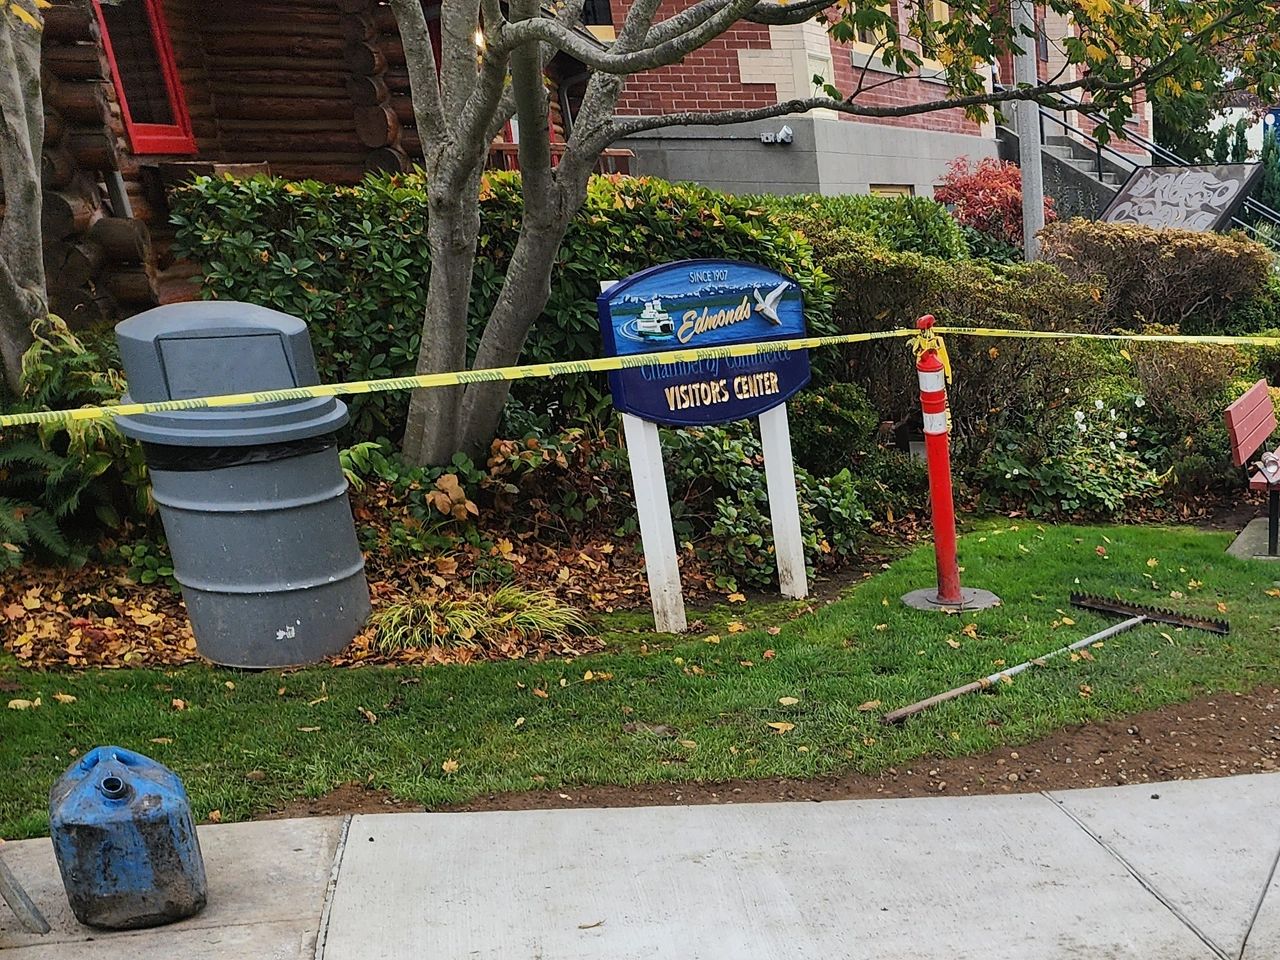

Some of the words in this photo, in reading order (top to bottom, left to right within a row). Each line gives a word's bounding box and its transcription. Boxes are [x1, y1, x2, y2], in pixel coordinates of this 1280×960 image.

[689, 271, 713, 283] SINCE
[712, 269, 729, 282] 1907
[676, 295, 751, 344] Edmonds
[664, 379, 729, 411] VISITORS
[733, 371, 780, 400] CENTER
